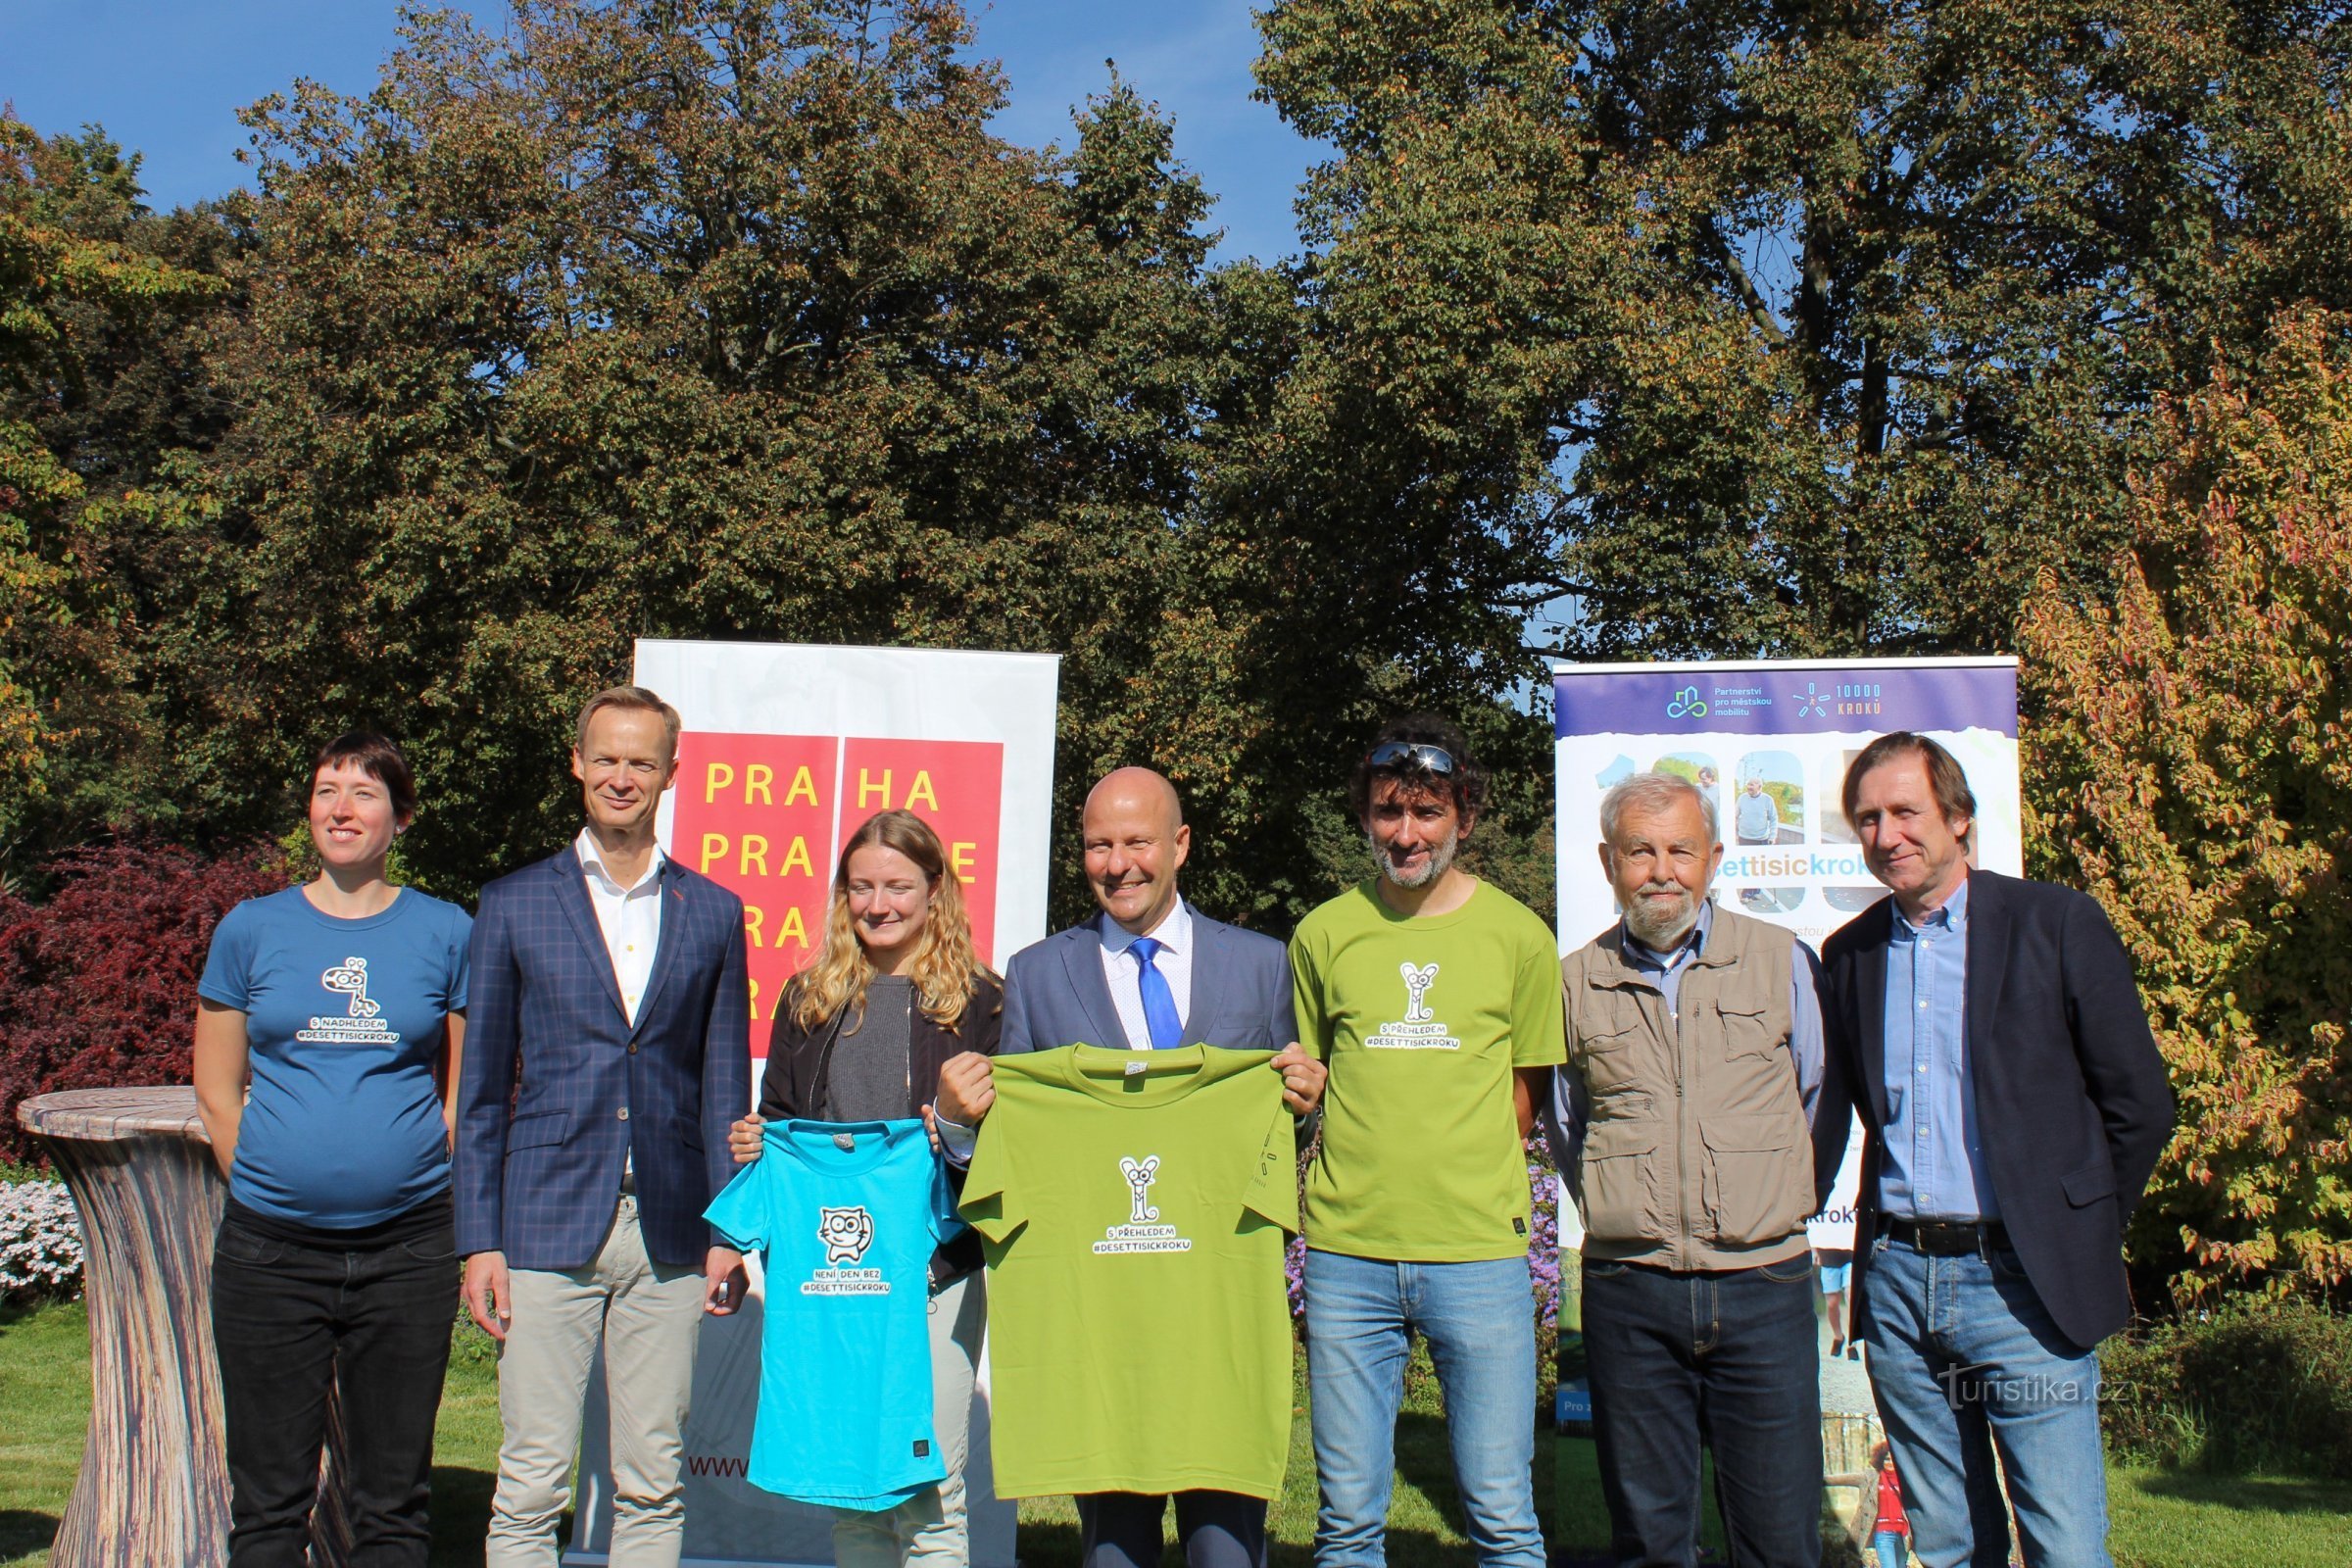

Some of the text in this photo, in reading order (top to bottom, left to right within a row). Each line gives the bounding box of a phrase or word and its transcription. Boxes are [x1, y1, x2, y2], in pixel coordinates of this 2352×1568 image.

[1715, 687, 1762, 696] Partnerství
[1837, 684, 1881, 698] 10000
[1715, 708, 1749, 716] mobilitu
[1838, 699, 1881, 715] KROKŮ
[700, 833, 814, 877] PRA
[1715, 853, 1873, 877] ettisickrok
[744, 905, 809, 949] RA
[312, 1018, 386, 1029] S NADHLEDEM
[1391, 1023, 1446, 1034] PŘEHLEDEM
[298, 1031, 399, 1041] #DESETTISICKROKU
[1367, 1038, 1459, 1048] #DESETTISICKROKU
[1107, 1227, 1175, 1238] S PŘEHLEDEM
[1094, 1242, 1191, 1251] #DESETTISICKROKU
[815, 1268, 837, 1278] NENÍ
[804, 1283, 891, 1292] #DESETTISICKROKU
[1564, 1400, 1584, 1411] Pro
